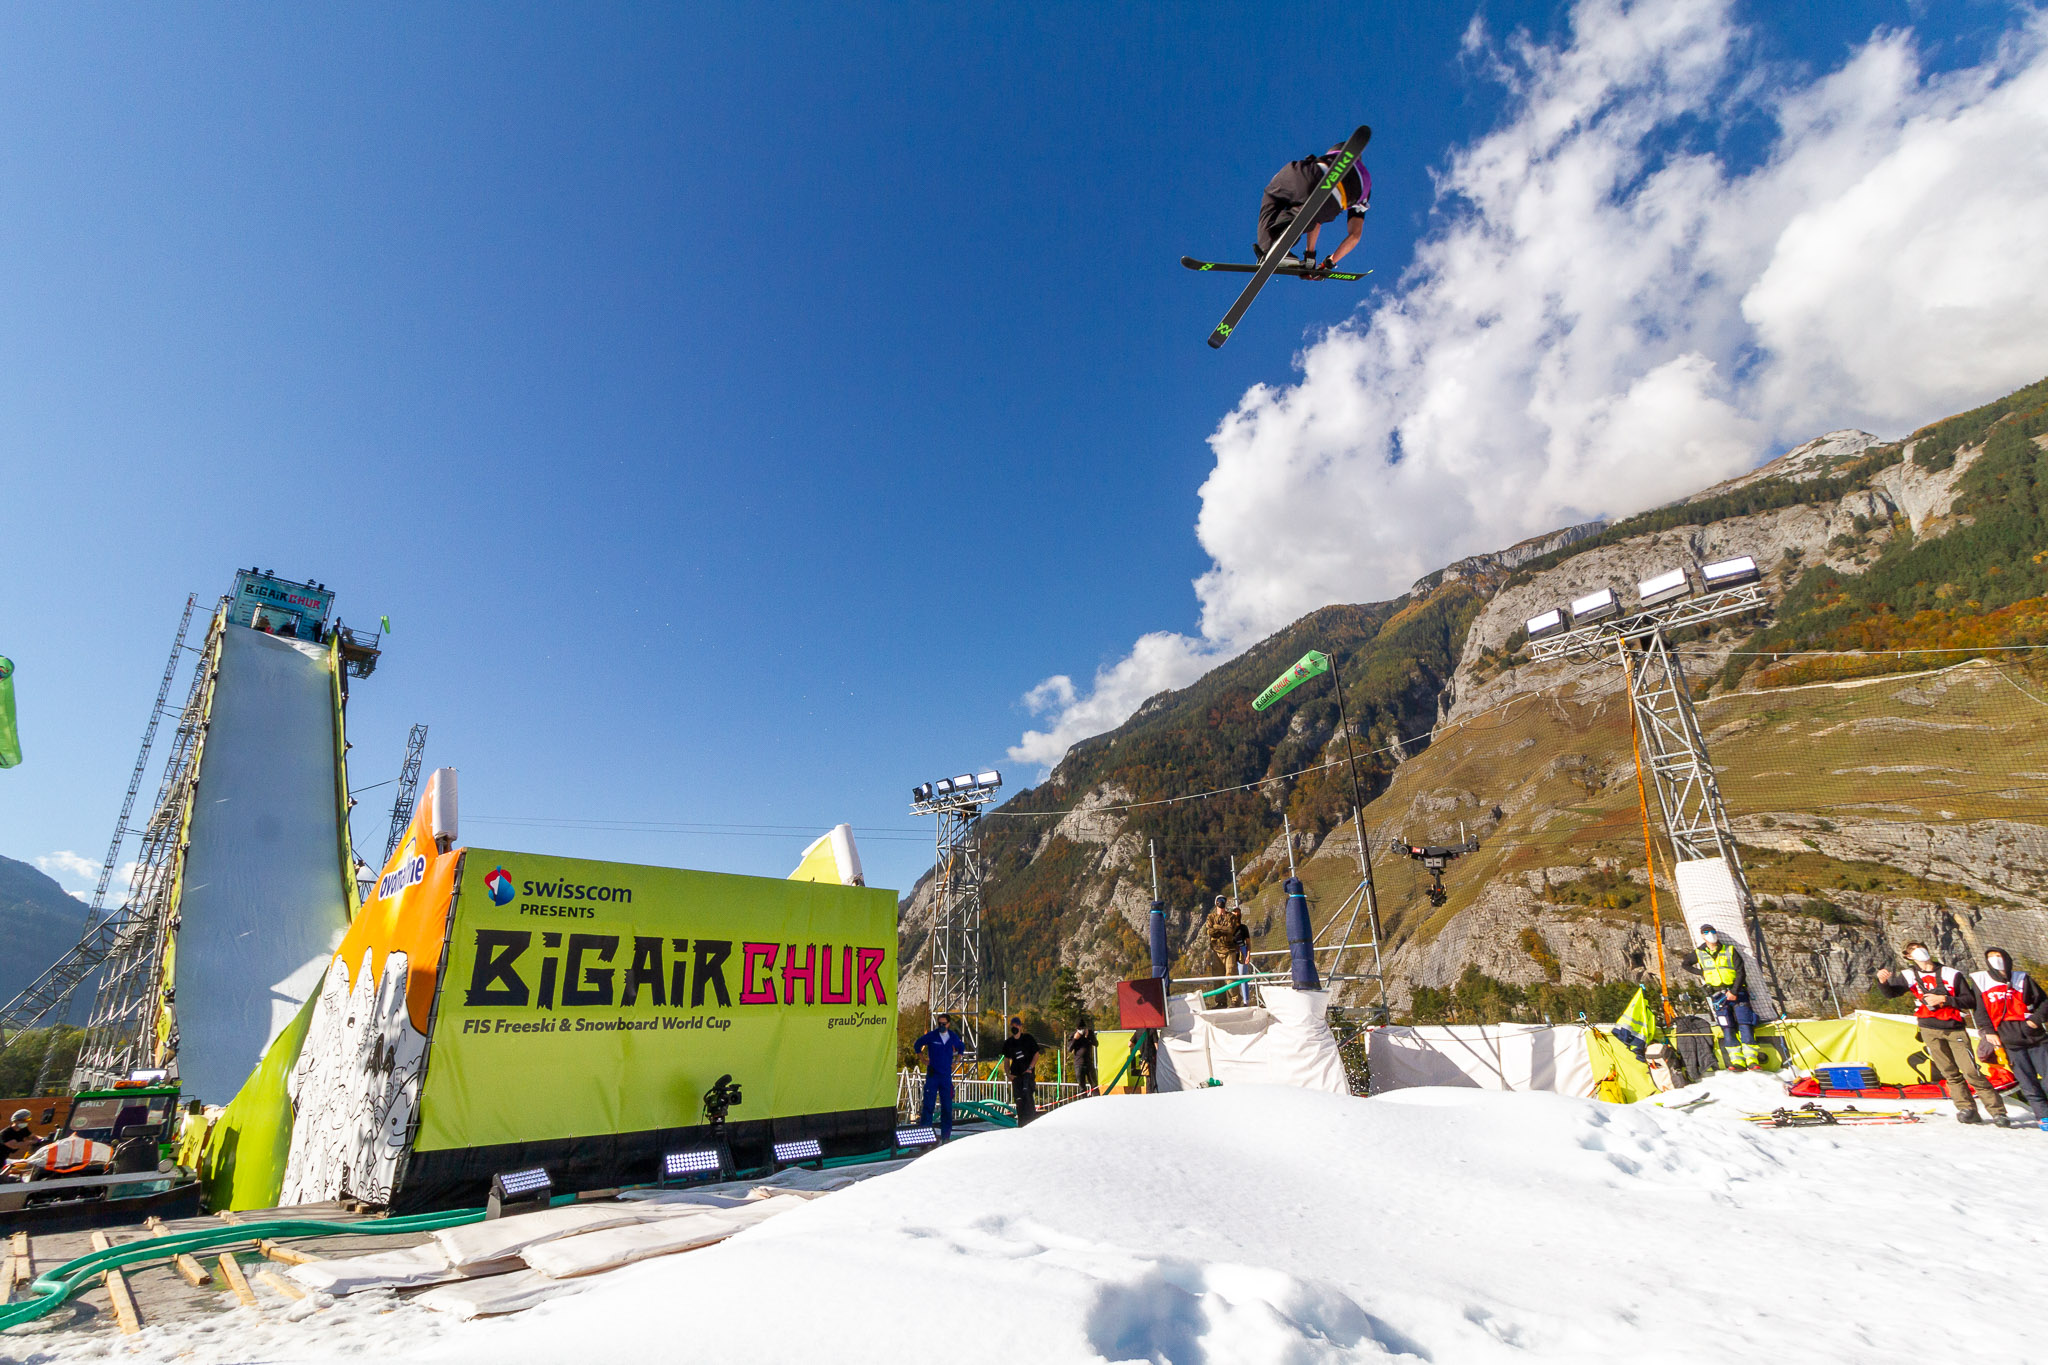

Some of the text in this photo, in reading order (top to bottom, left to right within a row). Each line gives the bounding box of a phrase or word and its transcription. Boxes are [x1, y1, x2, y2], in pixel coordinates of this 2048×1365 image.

[522, 877, 632, 903] swisscom
[520, 903, 595, 919] PRESENTS
[739, 942, 888, 1007] CHUR
[462, 1016, 731, 1034] FIS Freeski & Snowboard World Cup
[79, 1100, 106, 1108] EMILY
